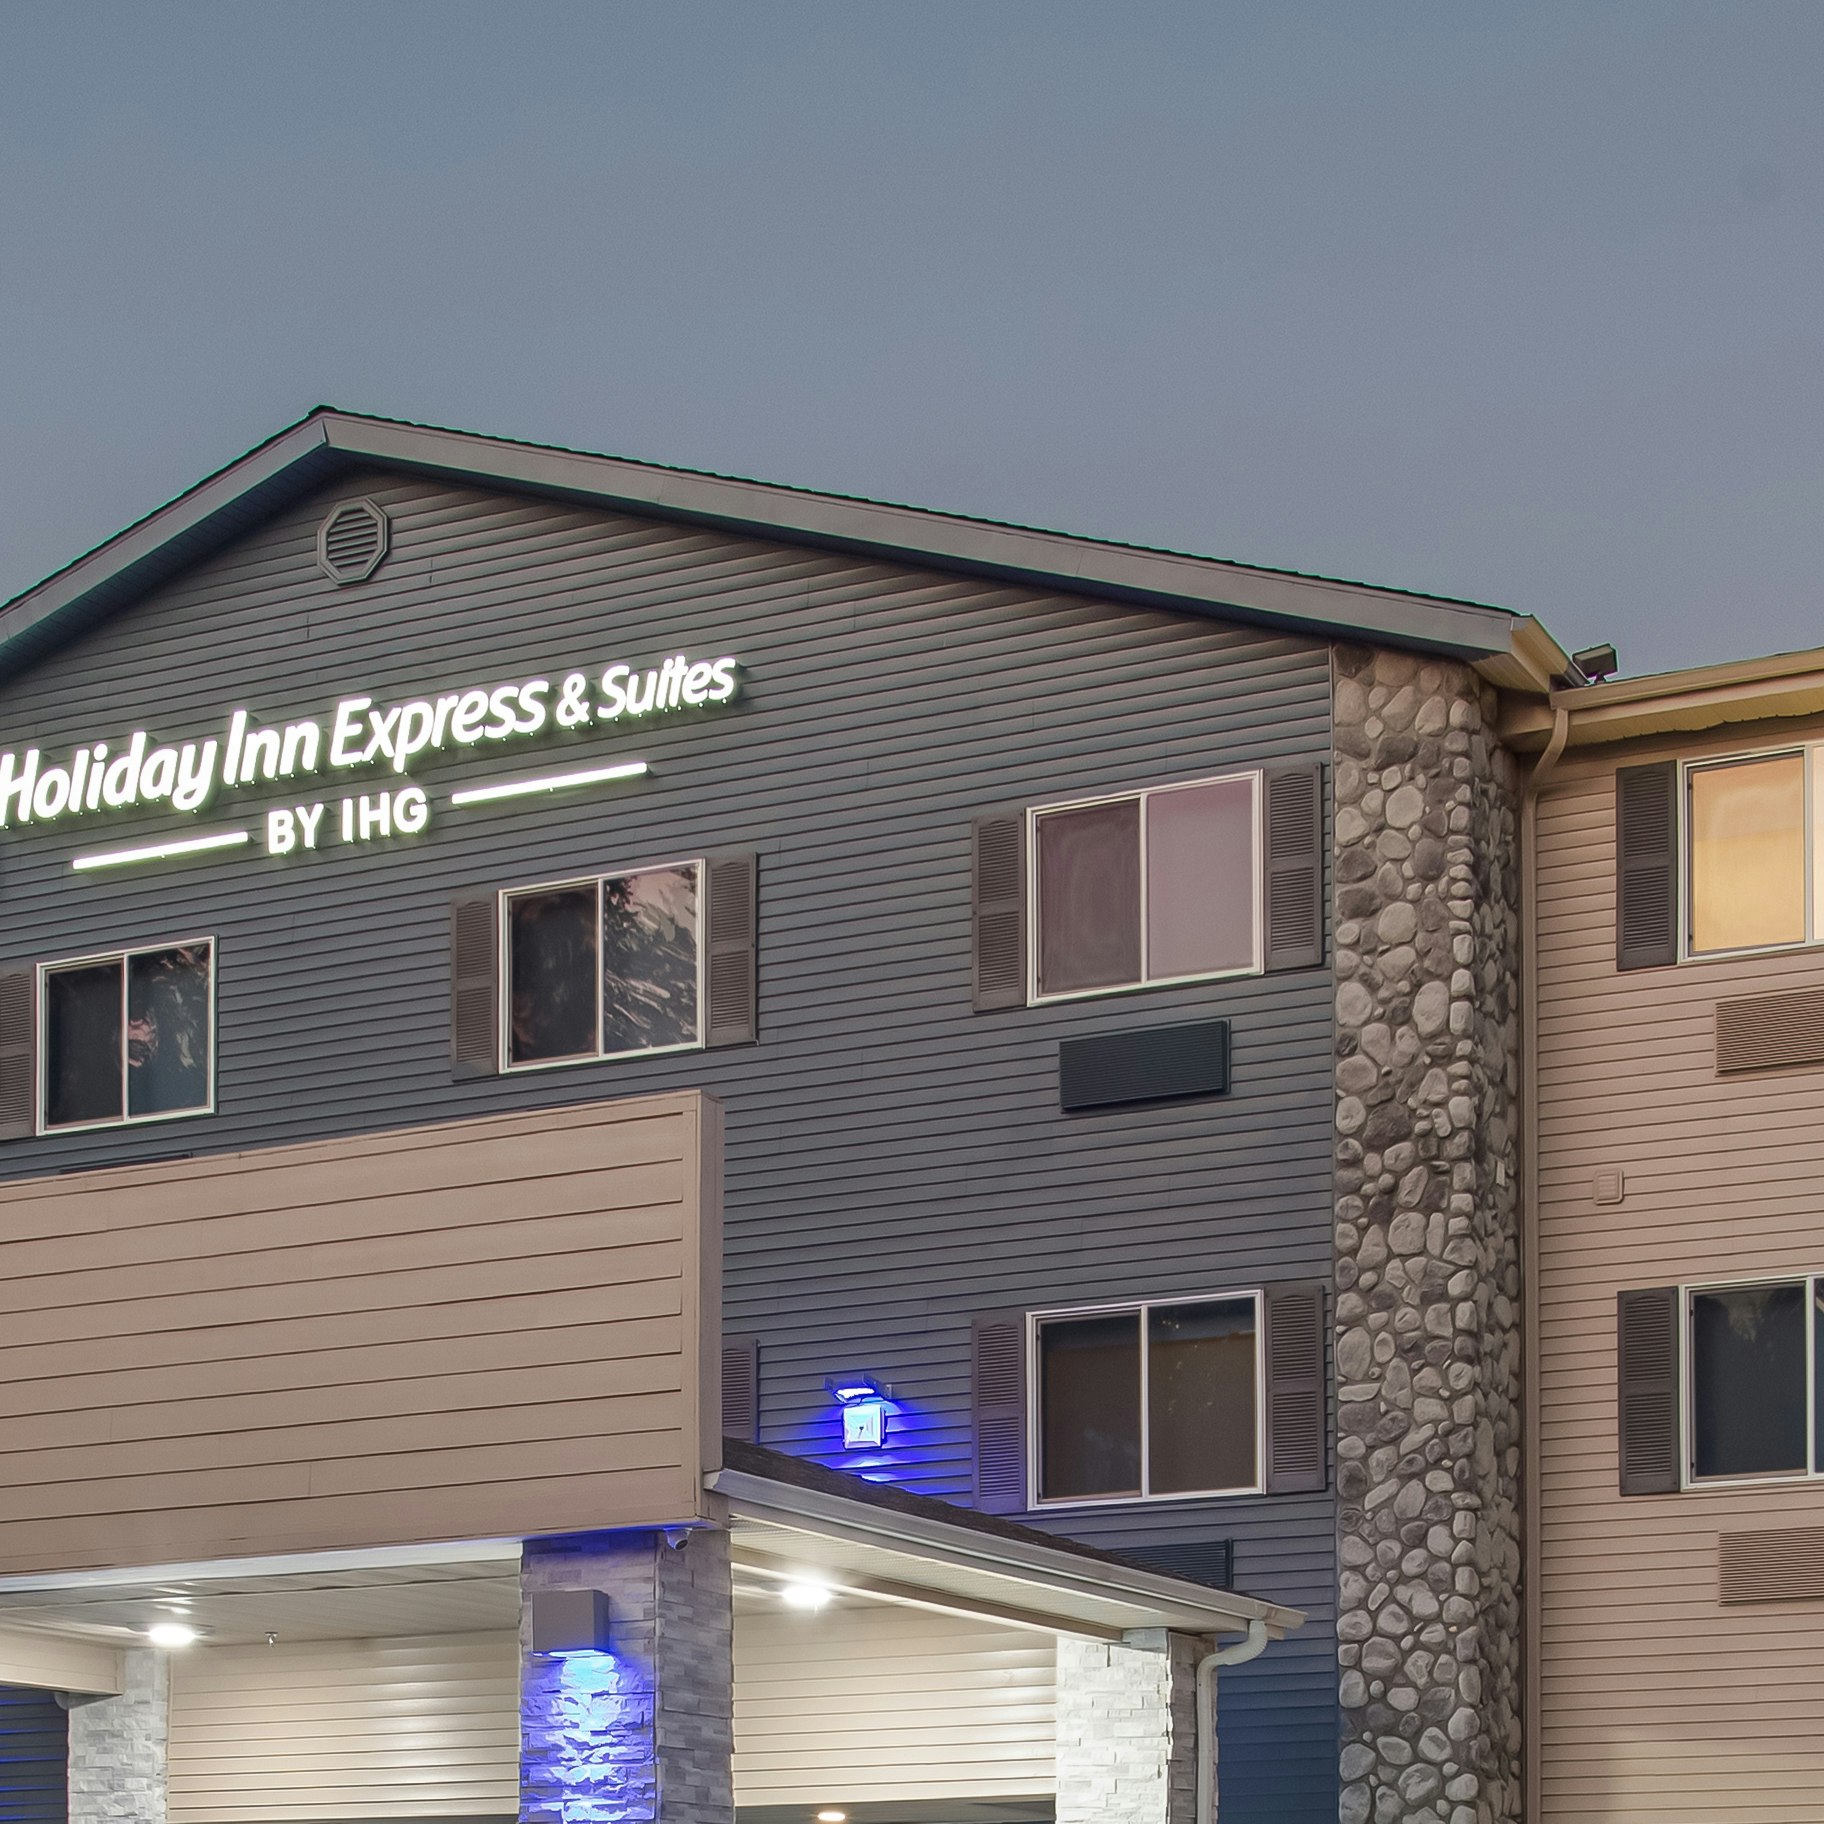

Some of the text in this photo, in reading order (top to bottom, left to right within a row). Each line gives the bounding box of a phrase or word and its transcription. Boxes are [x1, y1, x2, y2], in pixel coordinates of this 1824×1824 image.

[223, 709, 320, 787] Inn
[330, 680, 549, 774] Express
[555, 673, 590, 727] &
[597, 655, 736, 720] Suites
[267, 787, 428, 855] BY IHG
